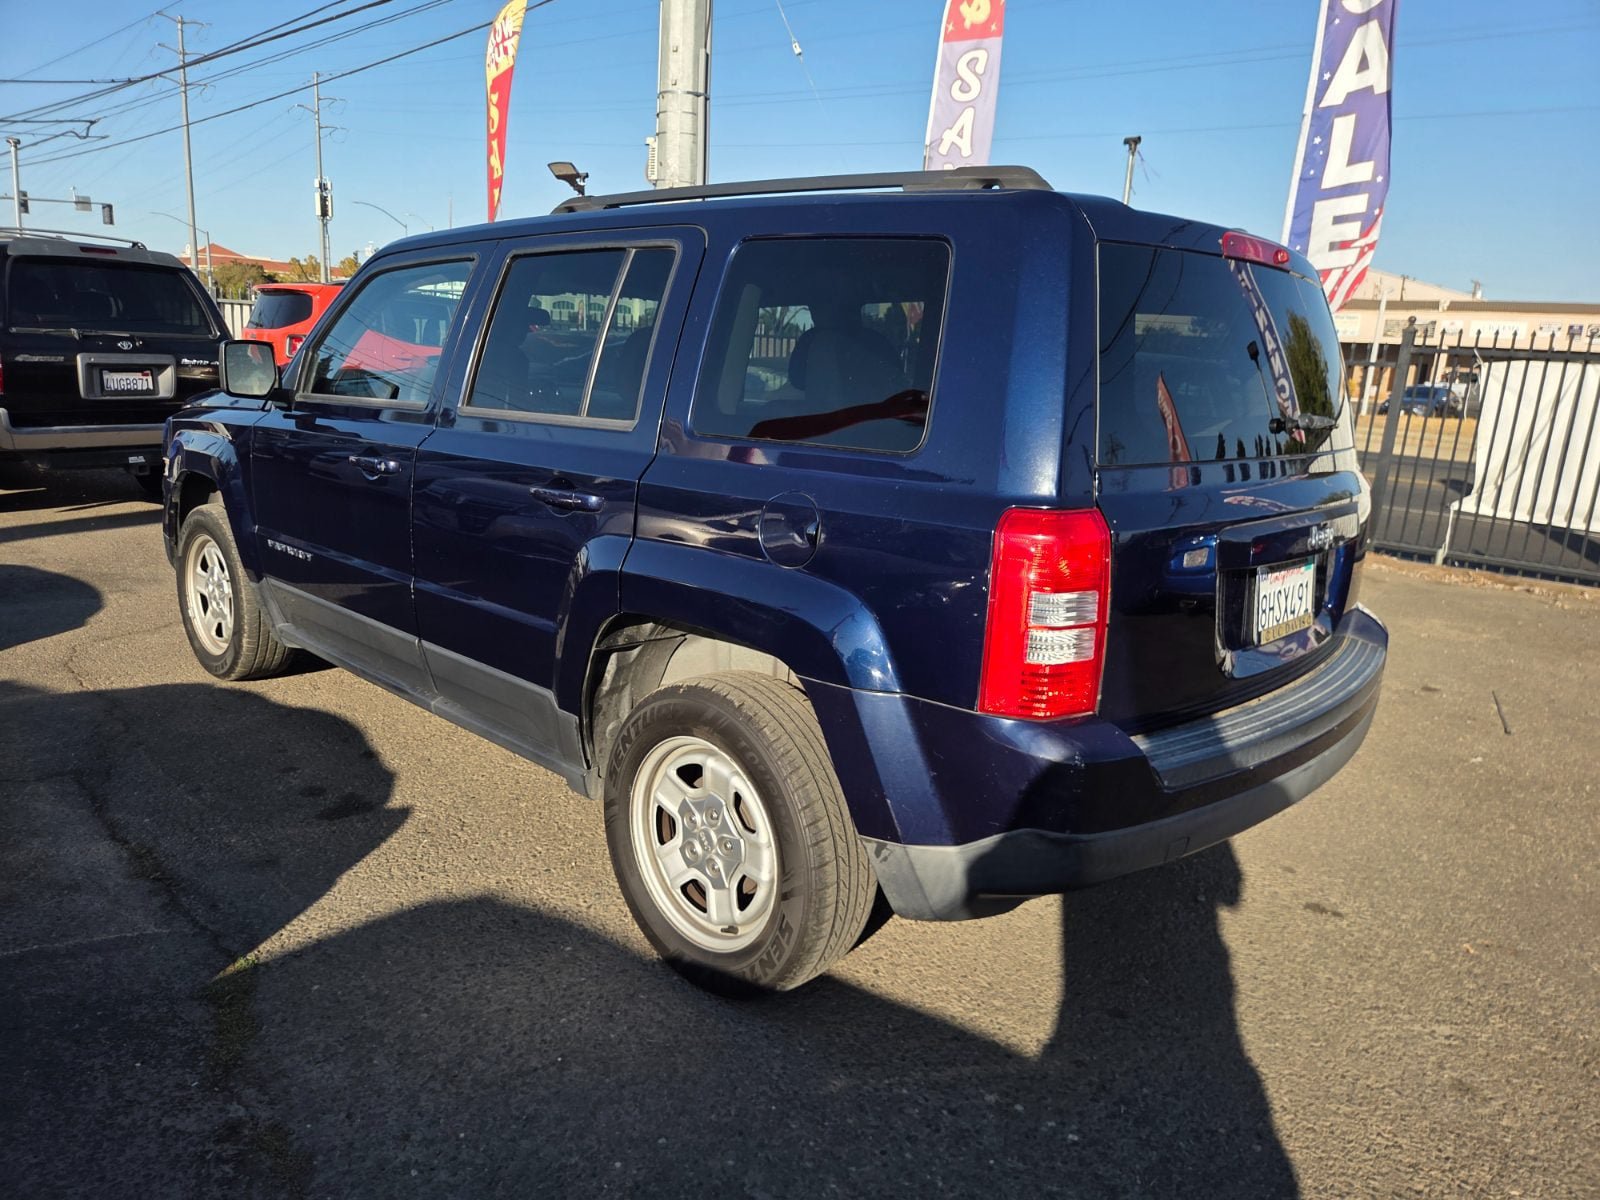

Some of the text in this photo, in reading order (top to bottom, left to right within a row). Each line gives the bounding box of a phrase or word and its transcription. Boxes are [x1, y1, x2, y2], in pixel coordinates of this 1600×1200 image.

[937, 47, 989, 170] SA
[1308, 0, 1392, 270] ALE
[105, 377, 150, 391] 4UGB871
[1307, 526, 1335, 551] Jeep
[1260, 580, 1309, 630] 8HSX491
